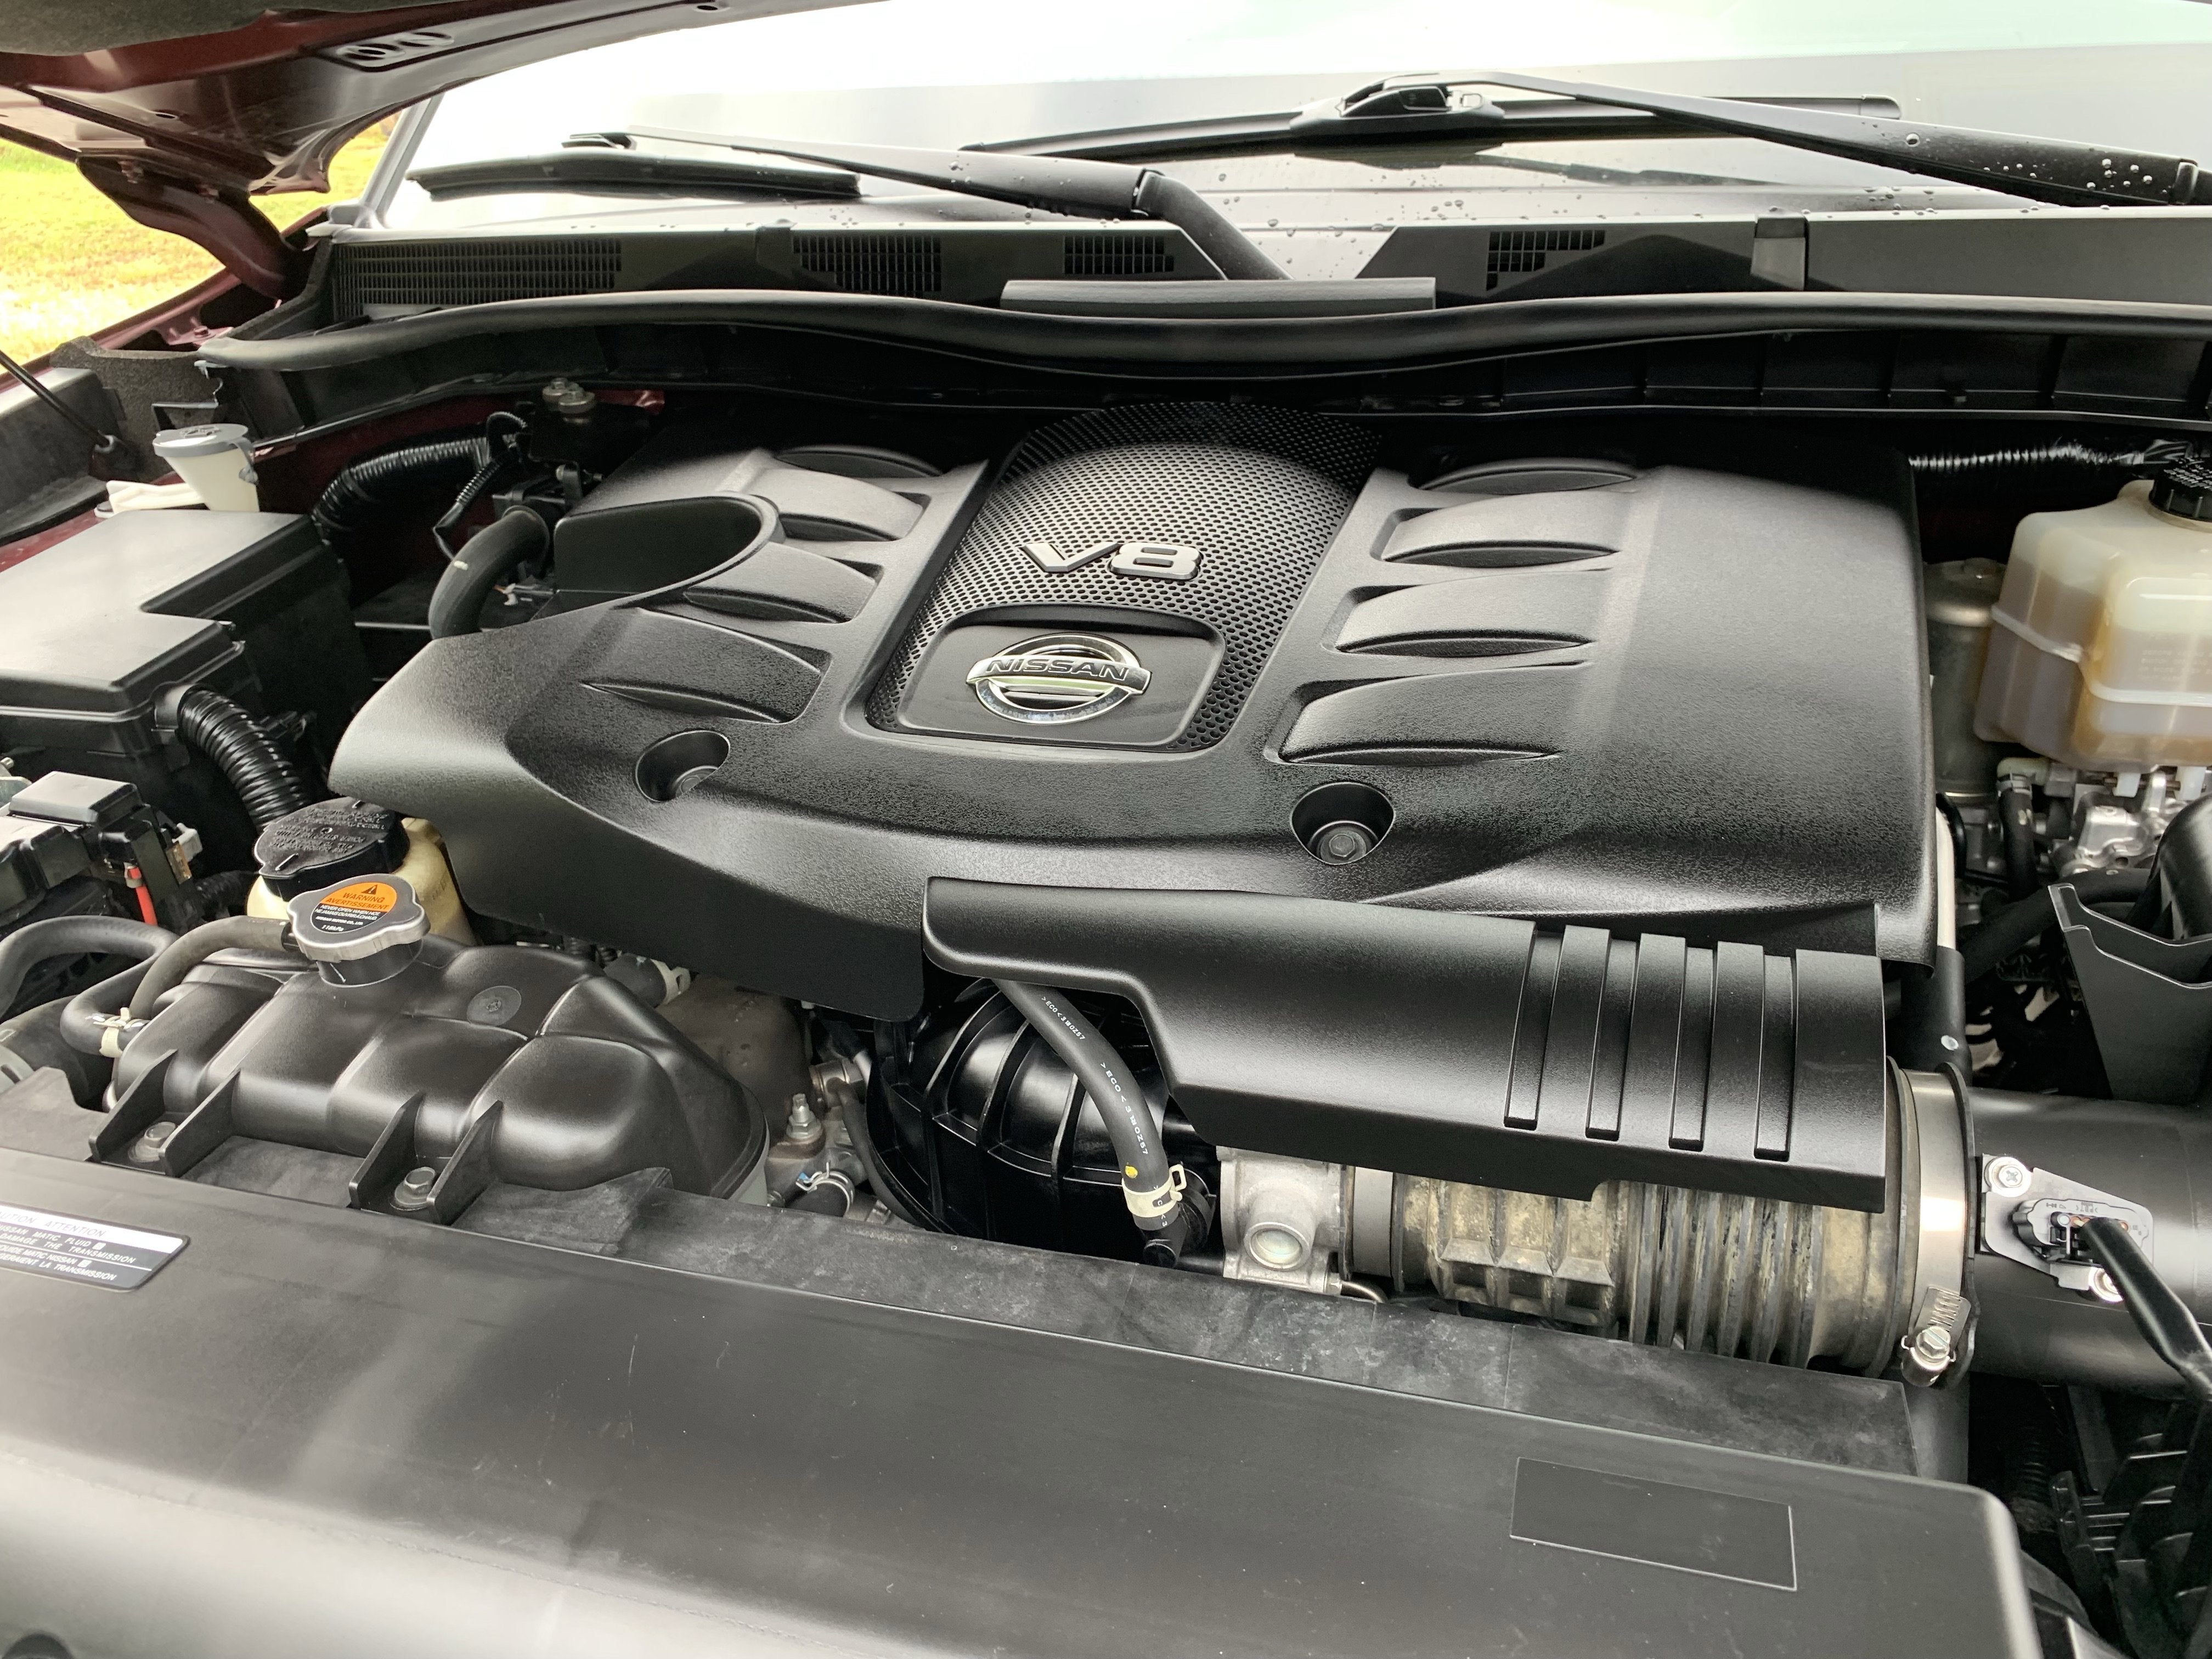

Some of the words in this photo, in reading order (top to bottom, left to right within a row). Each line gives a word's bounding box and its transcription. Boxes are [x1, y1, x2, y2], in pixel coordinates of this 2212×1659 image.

[1022, 542, 1202, 580] V8
[985, 658, 1130, 681] NISSAN
[326, 898, 390, 910] AVERTISSEMENT
[342, 893, 385, 902] WARNING
[0, 1211, 37, 1224] UTION
[44, 1221, 106, 1237] ATTENTION
[0, 1234, 38, 1245] DAMAGE
[44, 1241, 63, 1250] THE
[68, 1246, 136, 1264] TRANSMISSION
[32, 1231, 61, 1242] MATIC
[65, 1237, 92, 1247] FLUID
[22, 1249, 48, 1259] MATIC
[46, 1254, 78, 1265] NISSAN
[38, 1261, 52, 1269] LA
[53, 1263, 117, 1281] TRANSMISSION
